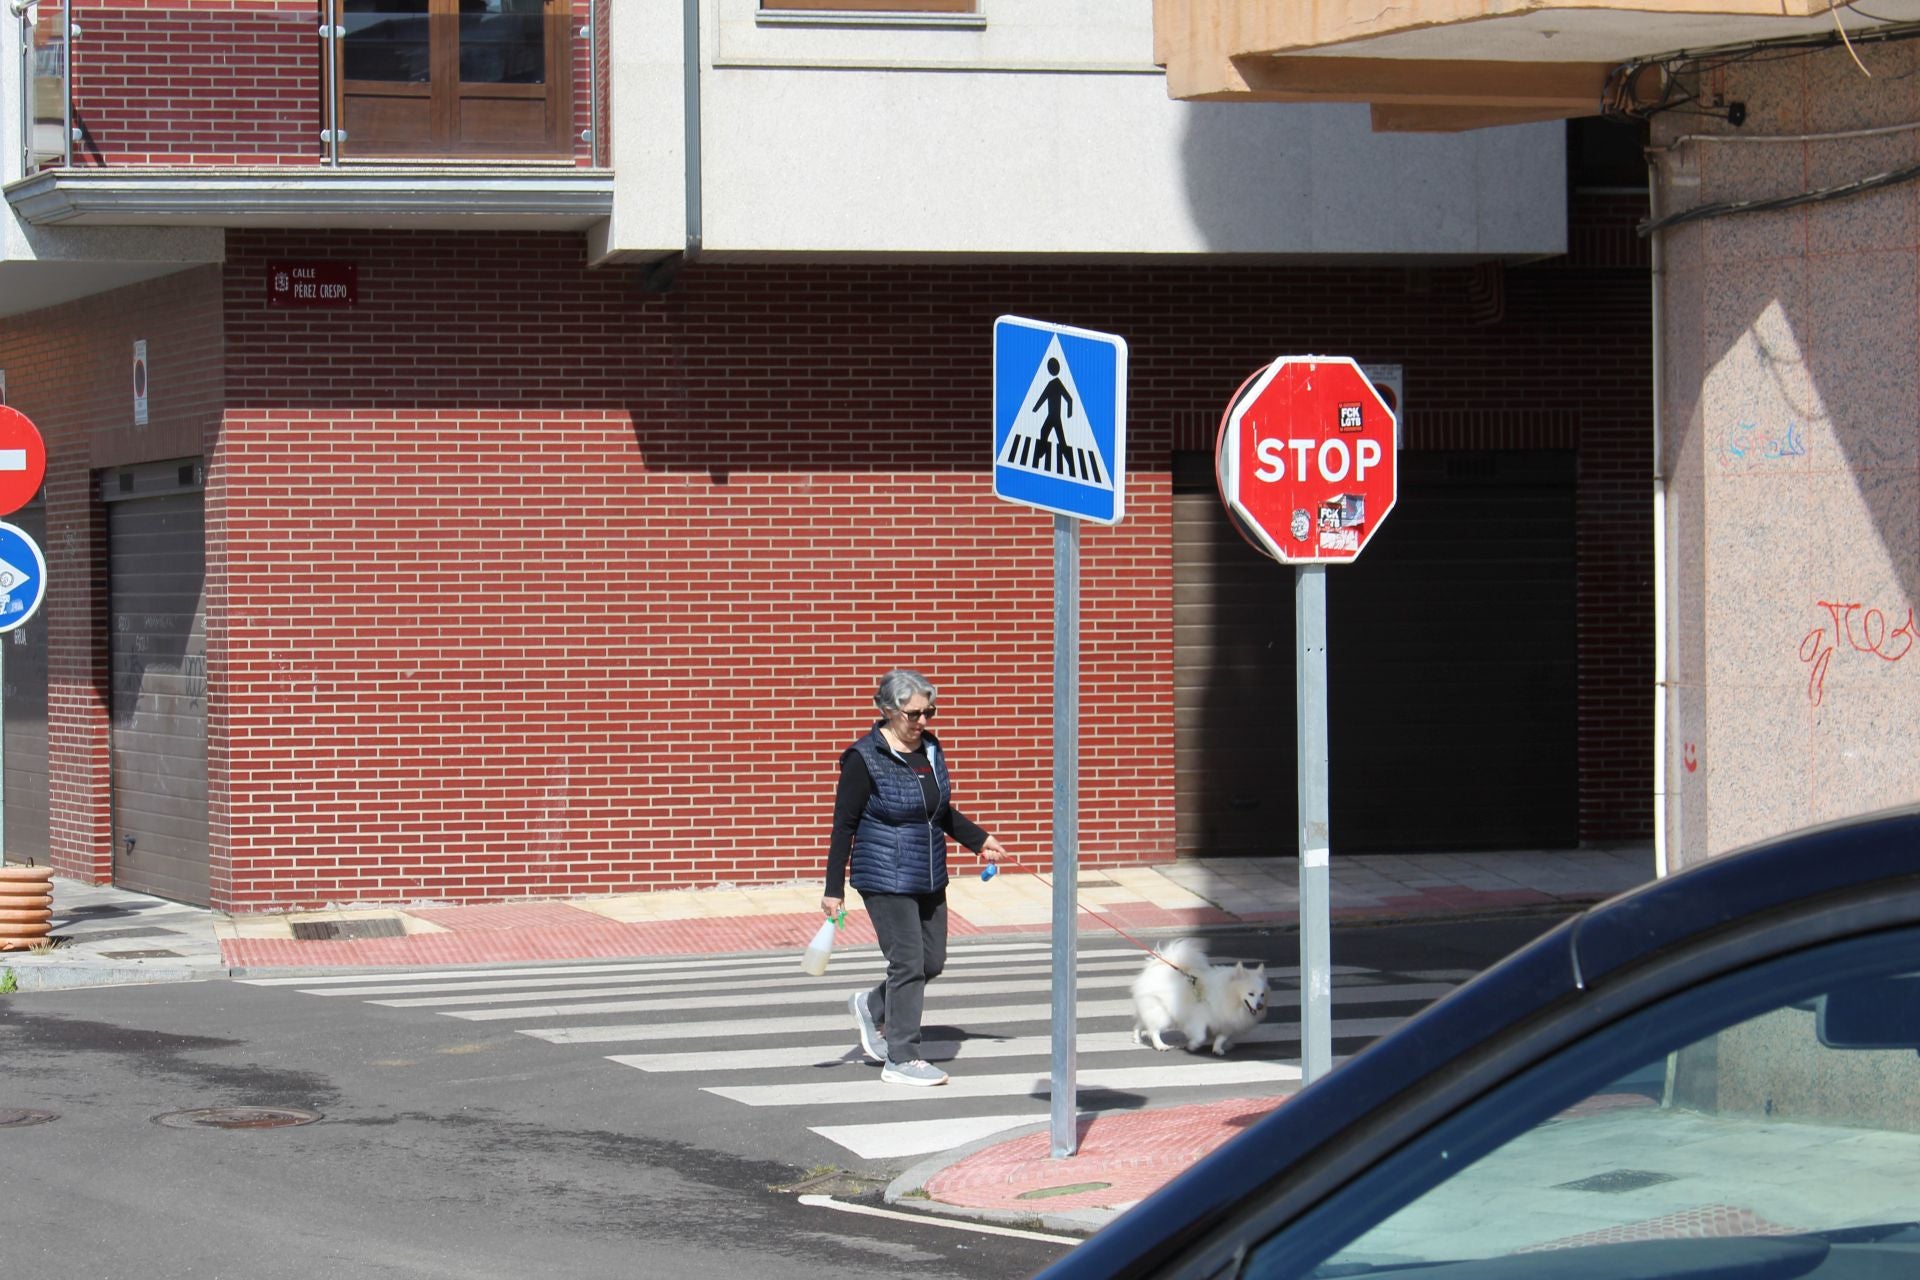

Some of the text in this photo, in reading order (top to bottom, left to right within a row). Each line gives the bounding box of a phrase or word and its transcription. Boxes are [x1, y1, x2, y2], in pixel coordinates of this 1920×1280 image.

[293, 268, 316, 279] CALLE
[320, 284, 347, 299] CRESPO
[1341, 407, 1360, 418] FCK
[1254, 438, 1381, 482] STOP
[1320, 508, 1340, 519] FCK
